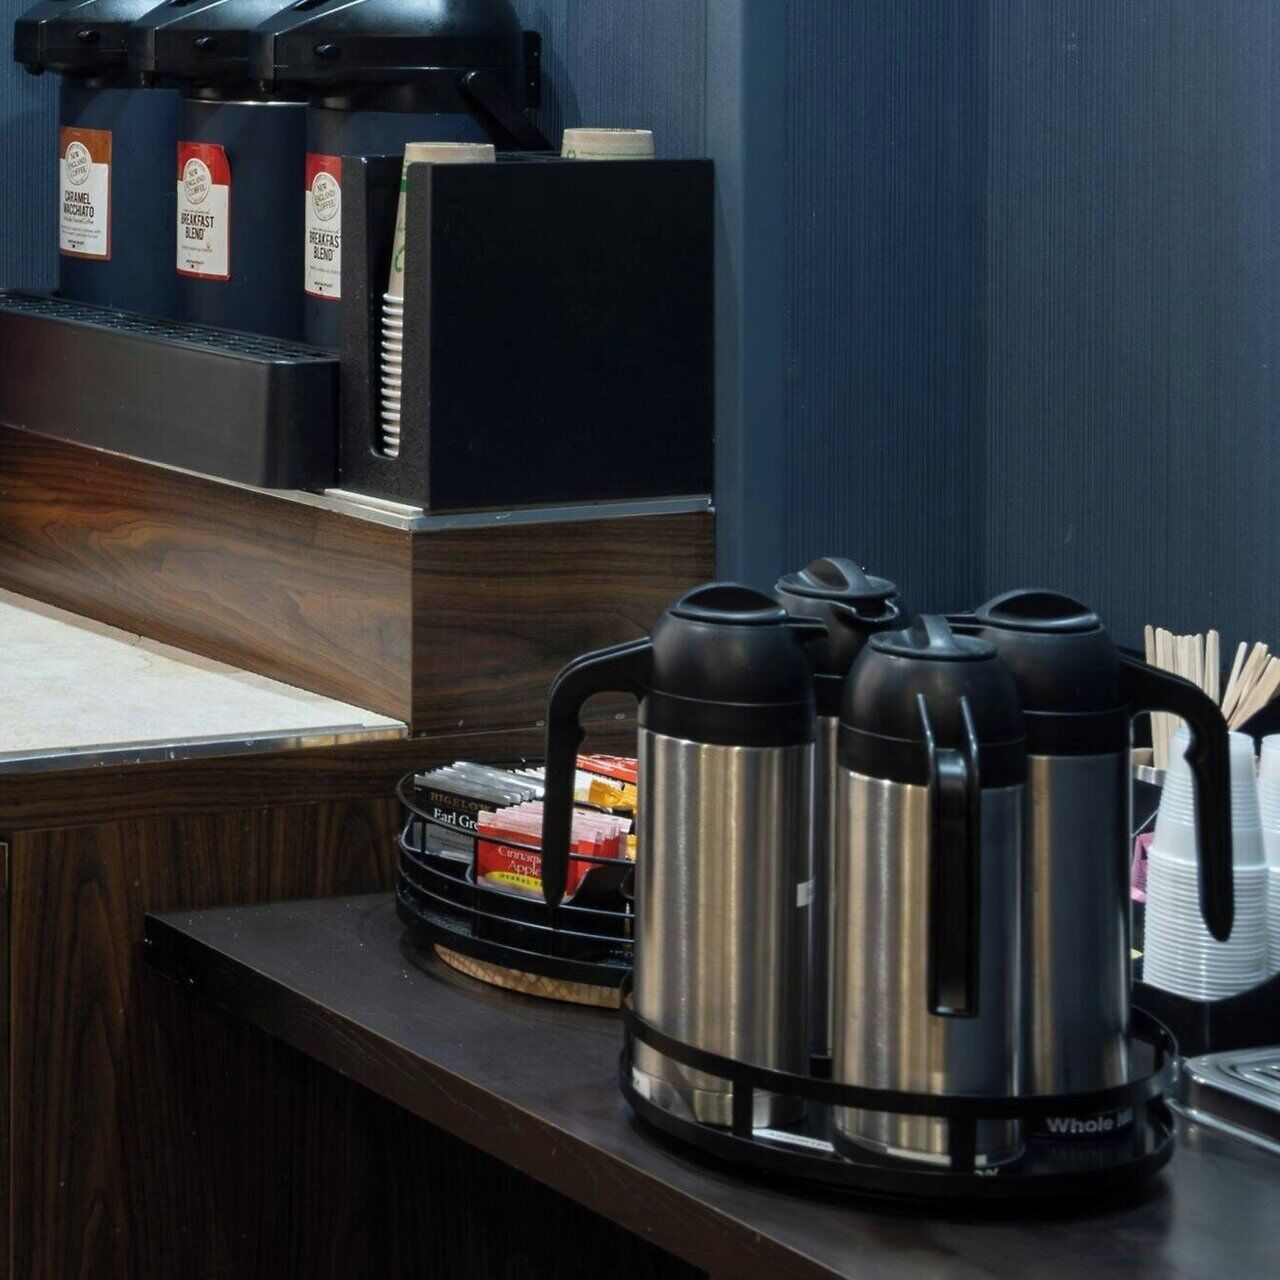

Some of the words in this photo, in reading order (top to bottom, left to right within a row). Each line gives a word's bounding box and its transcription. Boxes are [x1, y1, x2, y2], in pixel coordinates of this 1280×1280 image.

[64, 190, 92, 205] CARAMEL
[63, 202, 95, 218] MACCHIATO
[181, 212, 214, 228] BREAKFAST
[185, 226, 204, 240] BLEND
[313, 246, 333, 261] BLEND
[433, 807, 456, 825] Earl
[1046, 1117, 1113, 1133] Whole
